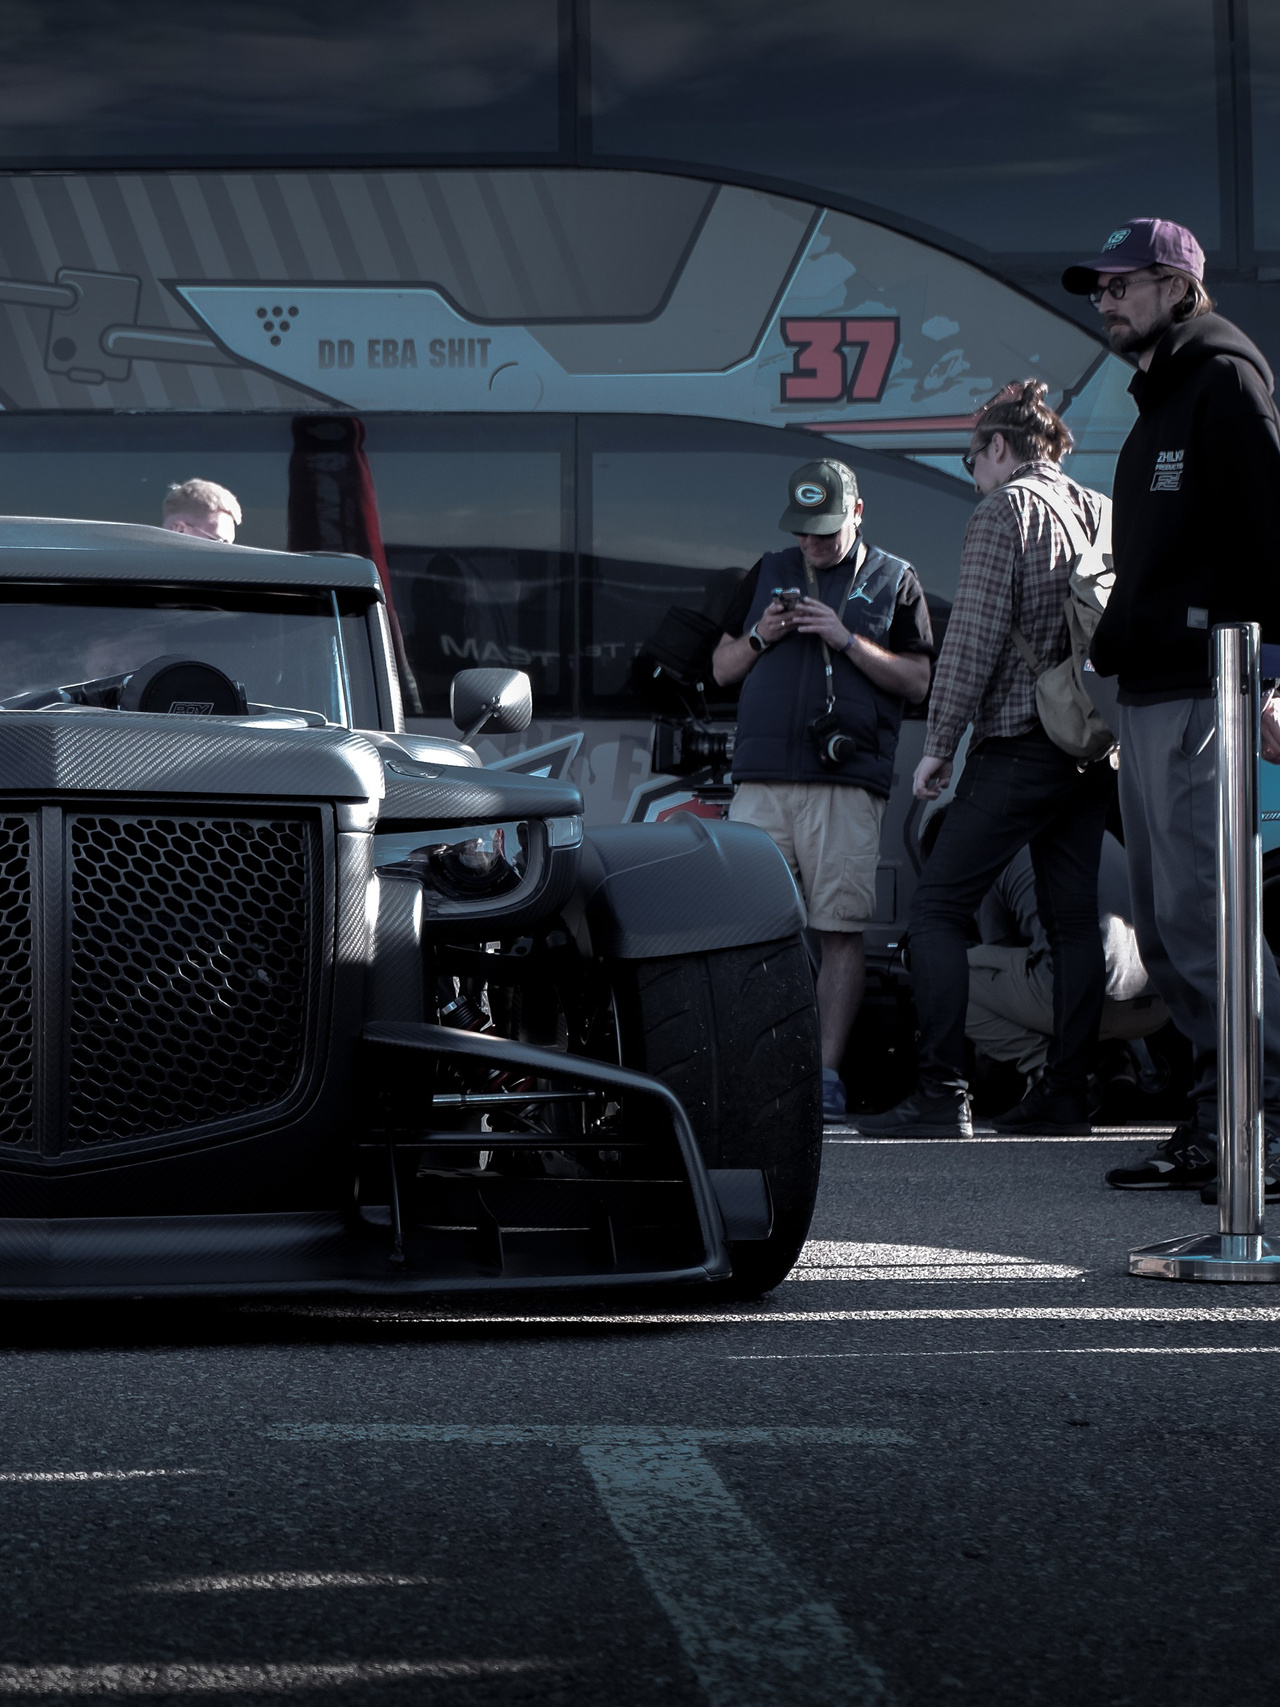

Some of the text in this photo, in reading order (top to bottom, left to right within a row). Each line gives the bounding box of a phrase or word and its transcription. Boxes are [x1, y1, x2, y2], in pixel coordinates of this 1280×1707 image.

[318, 337, 492, 369] DD EBA SHIT
[780, 316, 900, 404] 37
